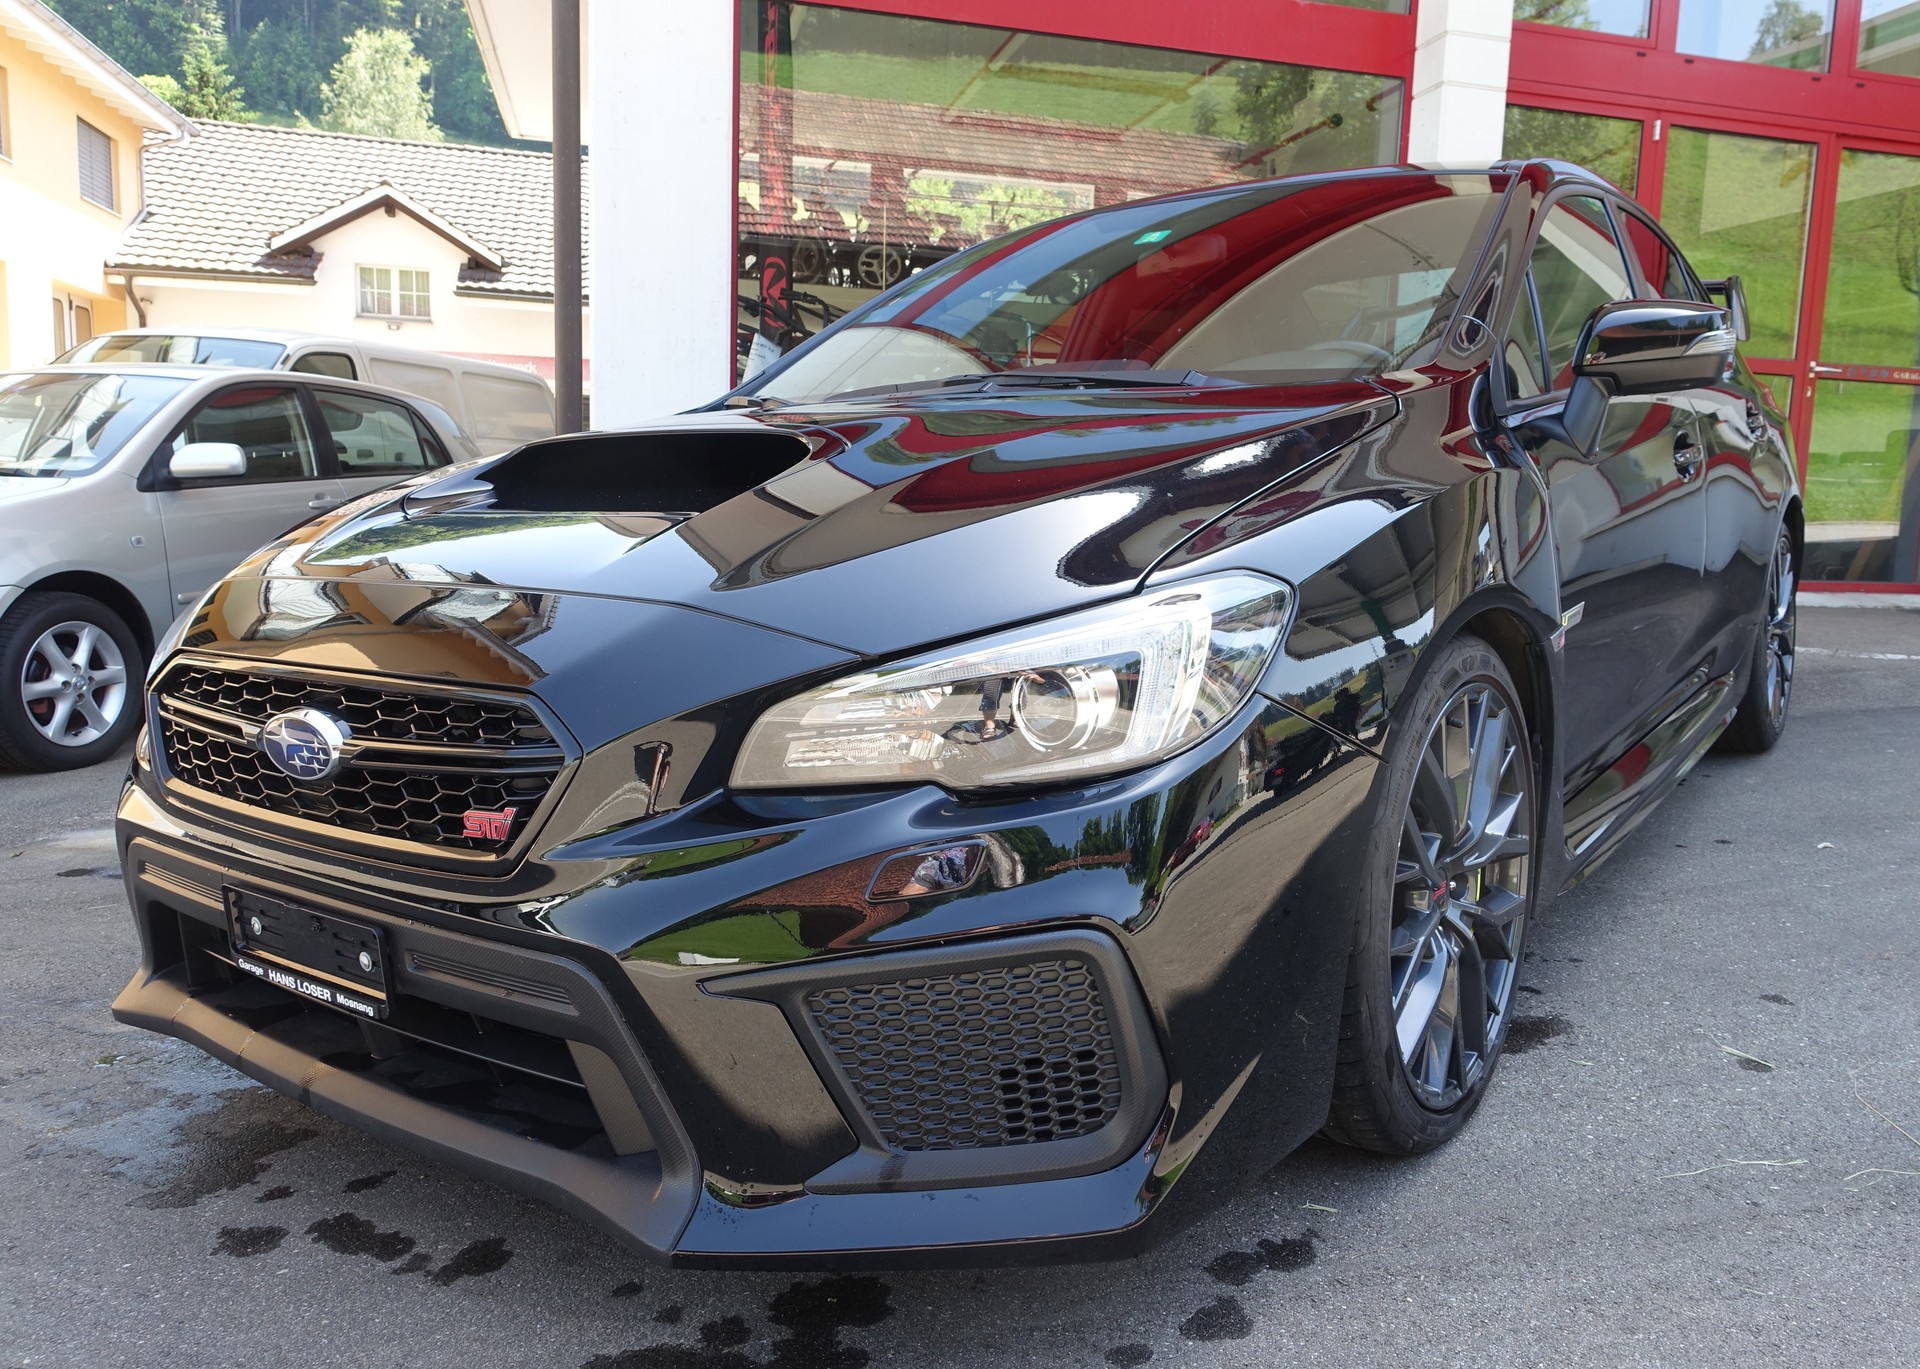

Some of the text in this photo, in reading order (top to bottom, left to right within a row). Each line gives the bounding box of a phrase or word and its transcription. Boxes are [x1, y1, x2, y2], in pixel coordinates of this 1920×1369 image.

[238, 959, 373, 1016] Garage HANS LOSER Mosnang
